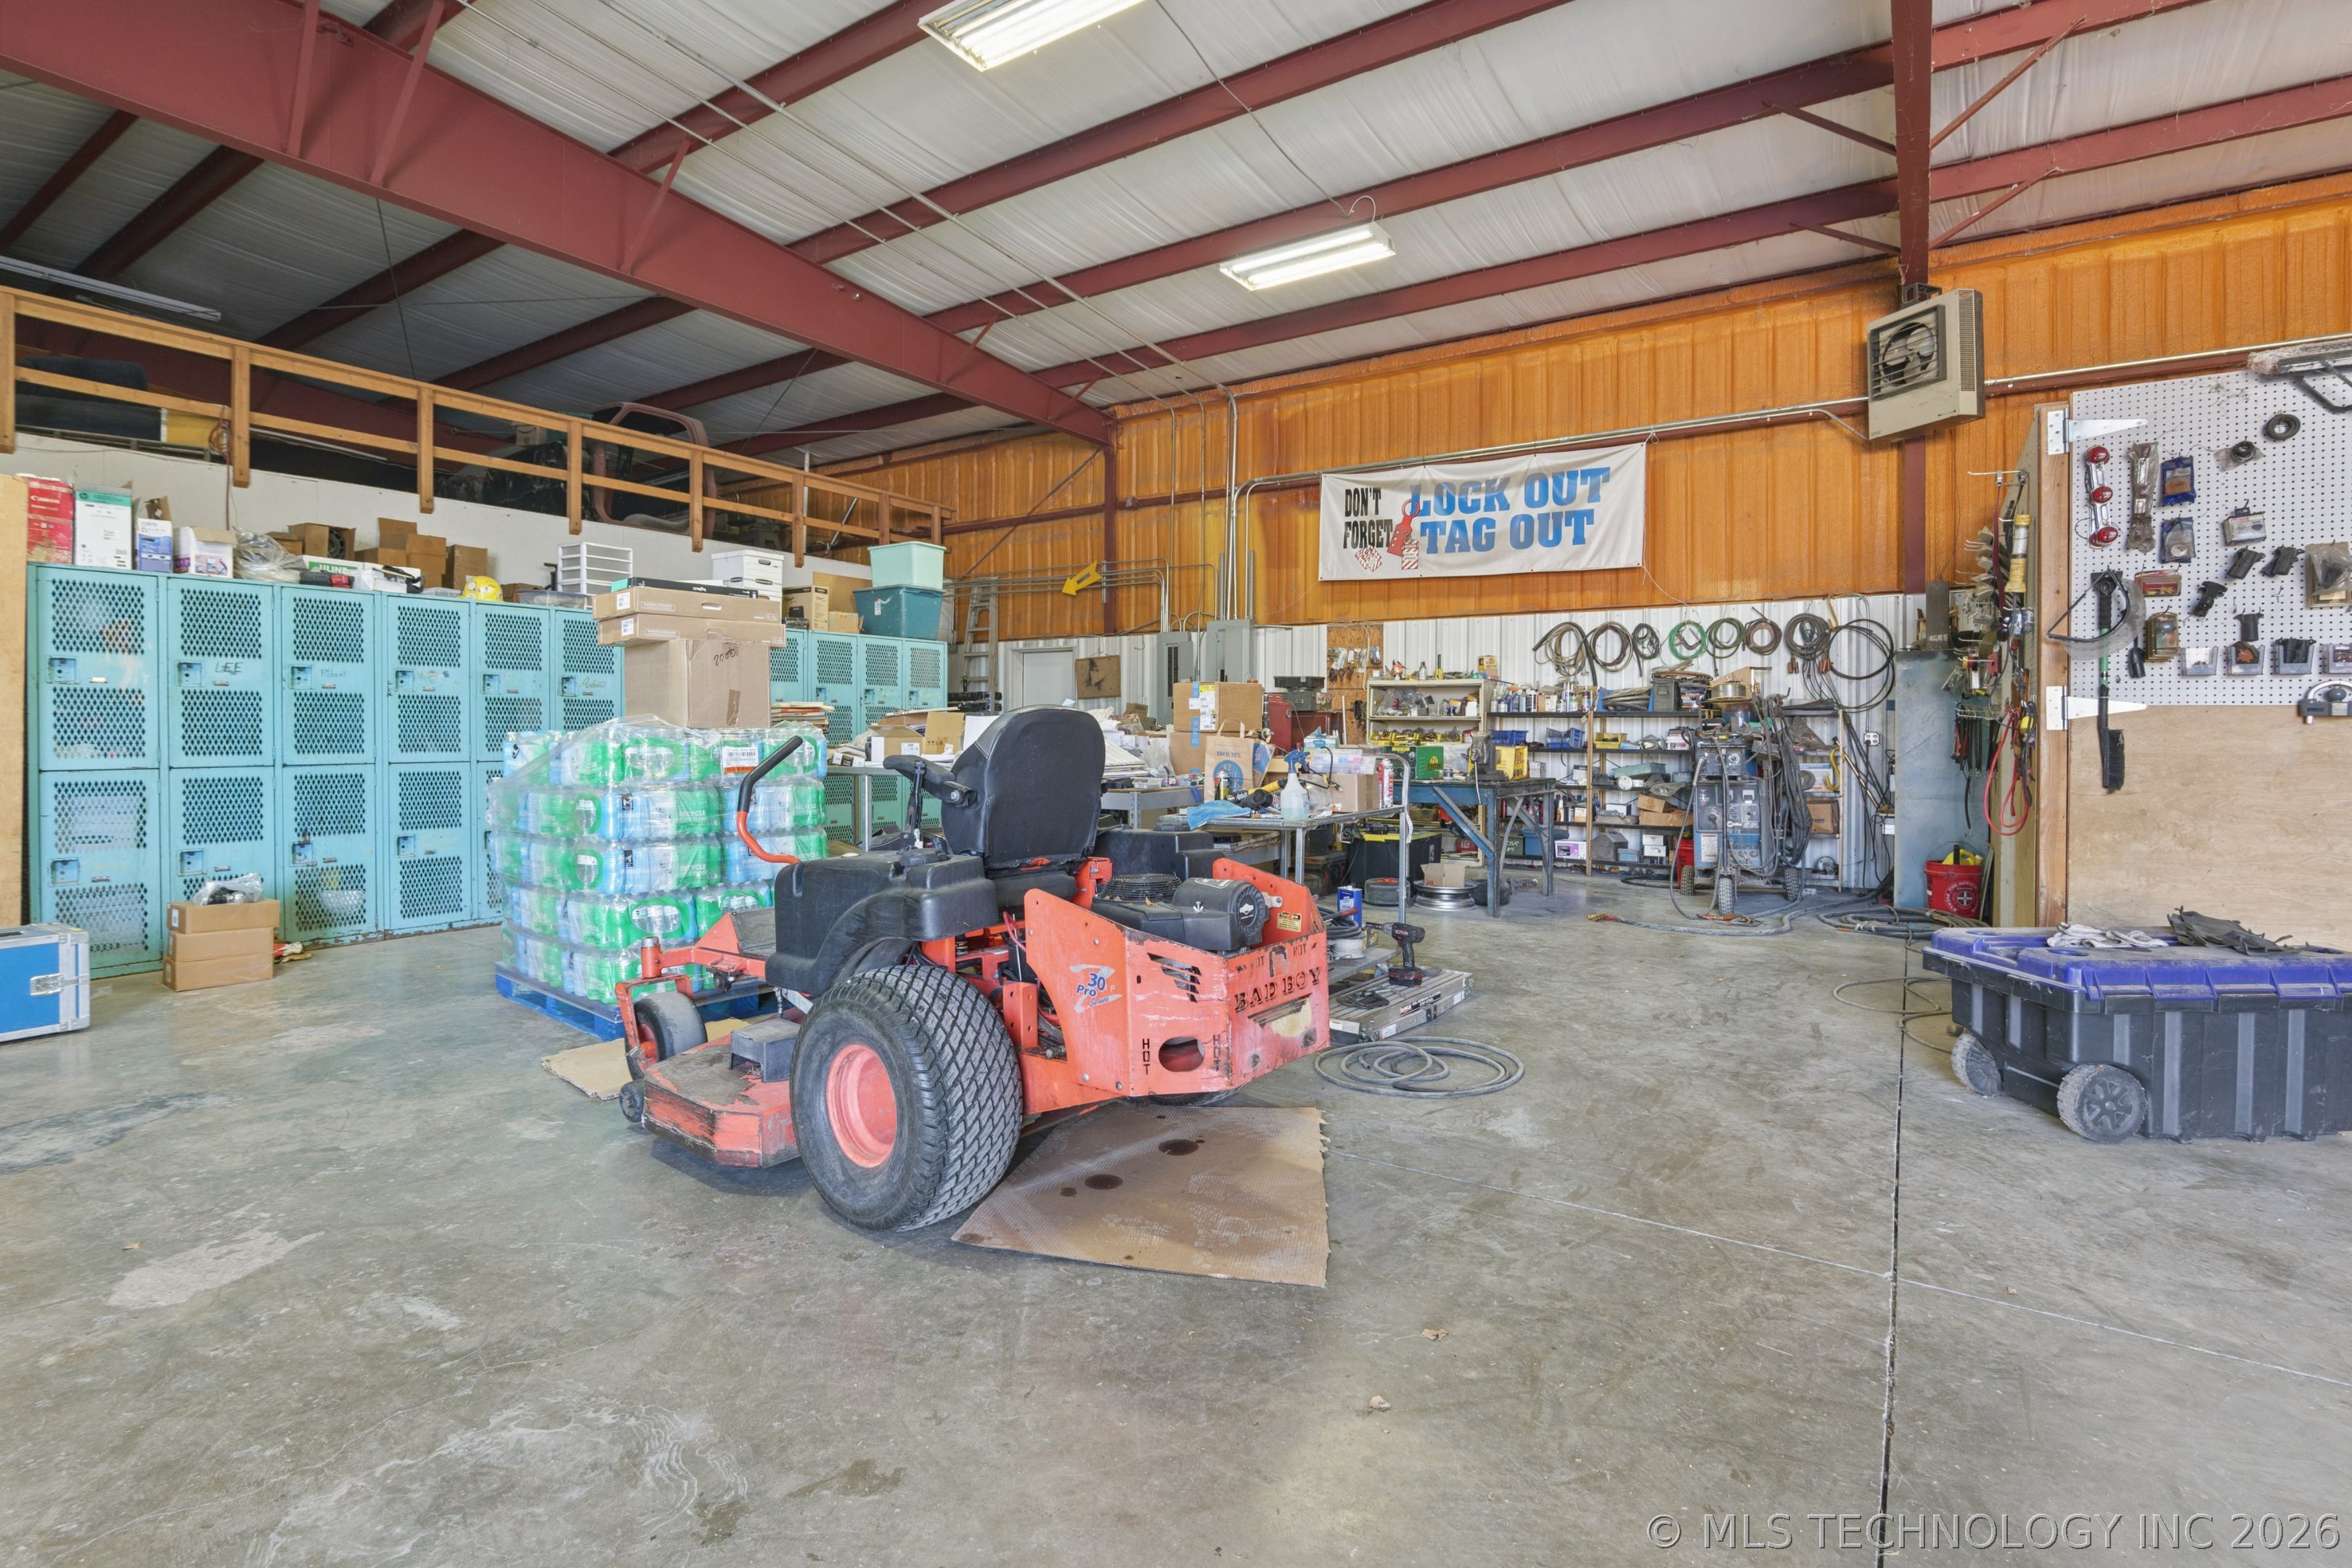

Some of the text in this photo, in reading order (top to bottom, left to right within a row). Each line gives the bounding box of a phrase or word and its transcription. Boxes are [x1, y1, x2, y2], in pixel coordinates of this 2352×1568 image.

[30, 495, 60, 504] Canon
[1344, 486, 1382, 517] DON'T
[1409, 466, 1611, 517] LOCK OUT
[1343, 519, 1393, 549] FORGET
[1420, 508, 1594, 554] TAG OUT
[216, 661, 245, 674] LEE
[1076, 984, 1097, 997] Pro
[1087, 973, 1106, 992] 30
[1235, 966, 1322, 1013] BAD BOY
[1142, 1037, 1151, 1075] HOT
